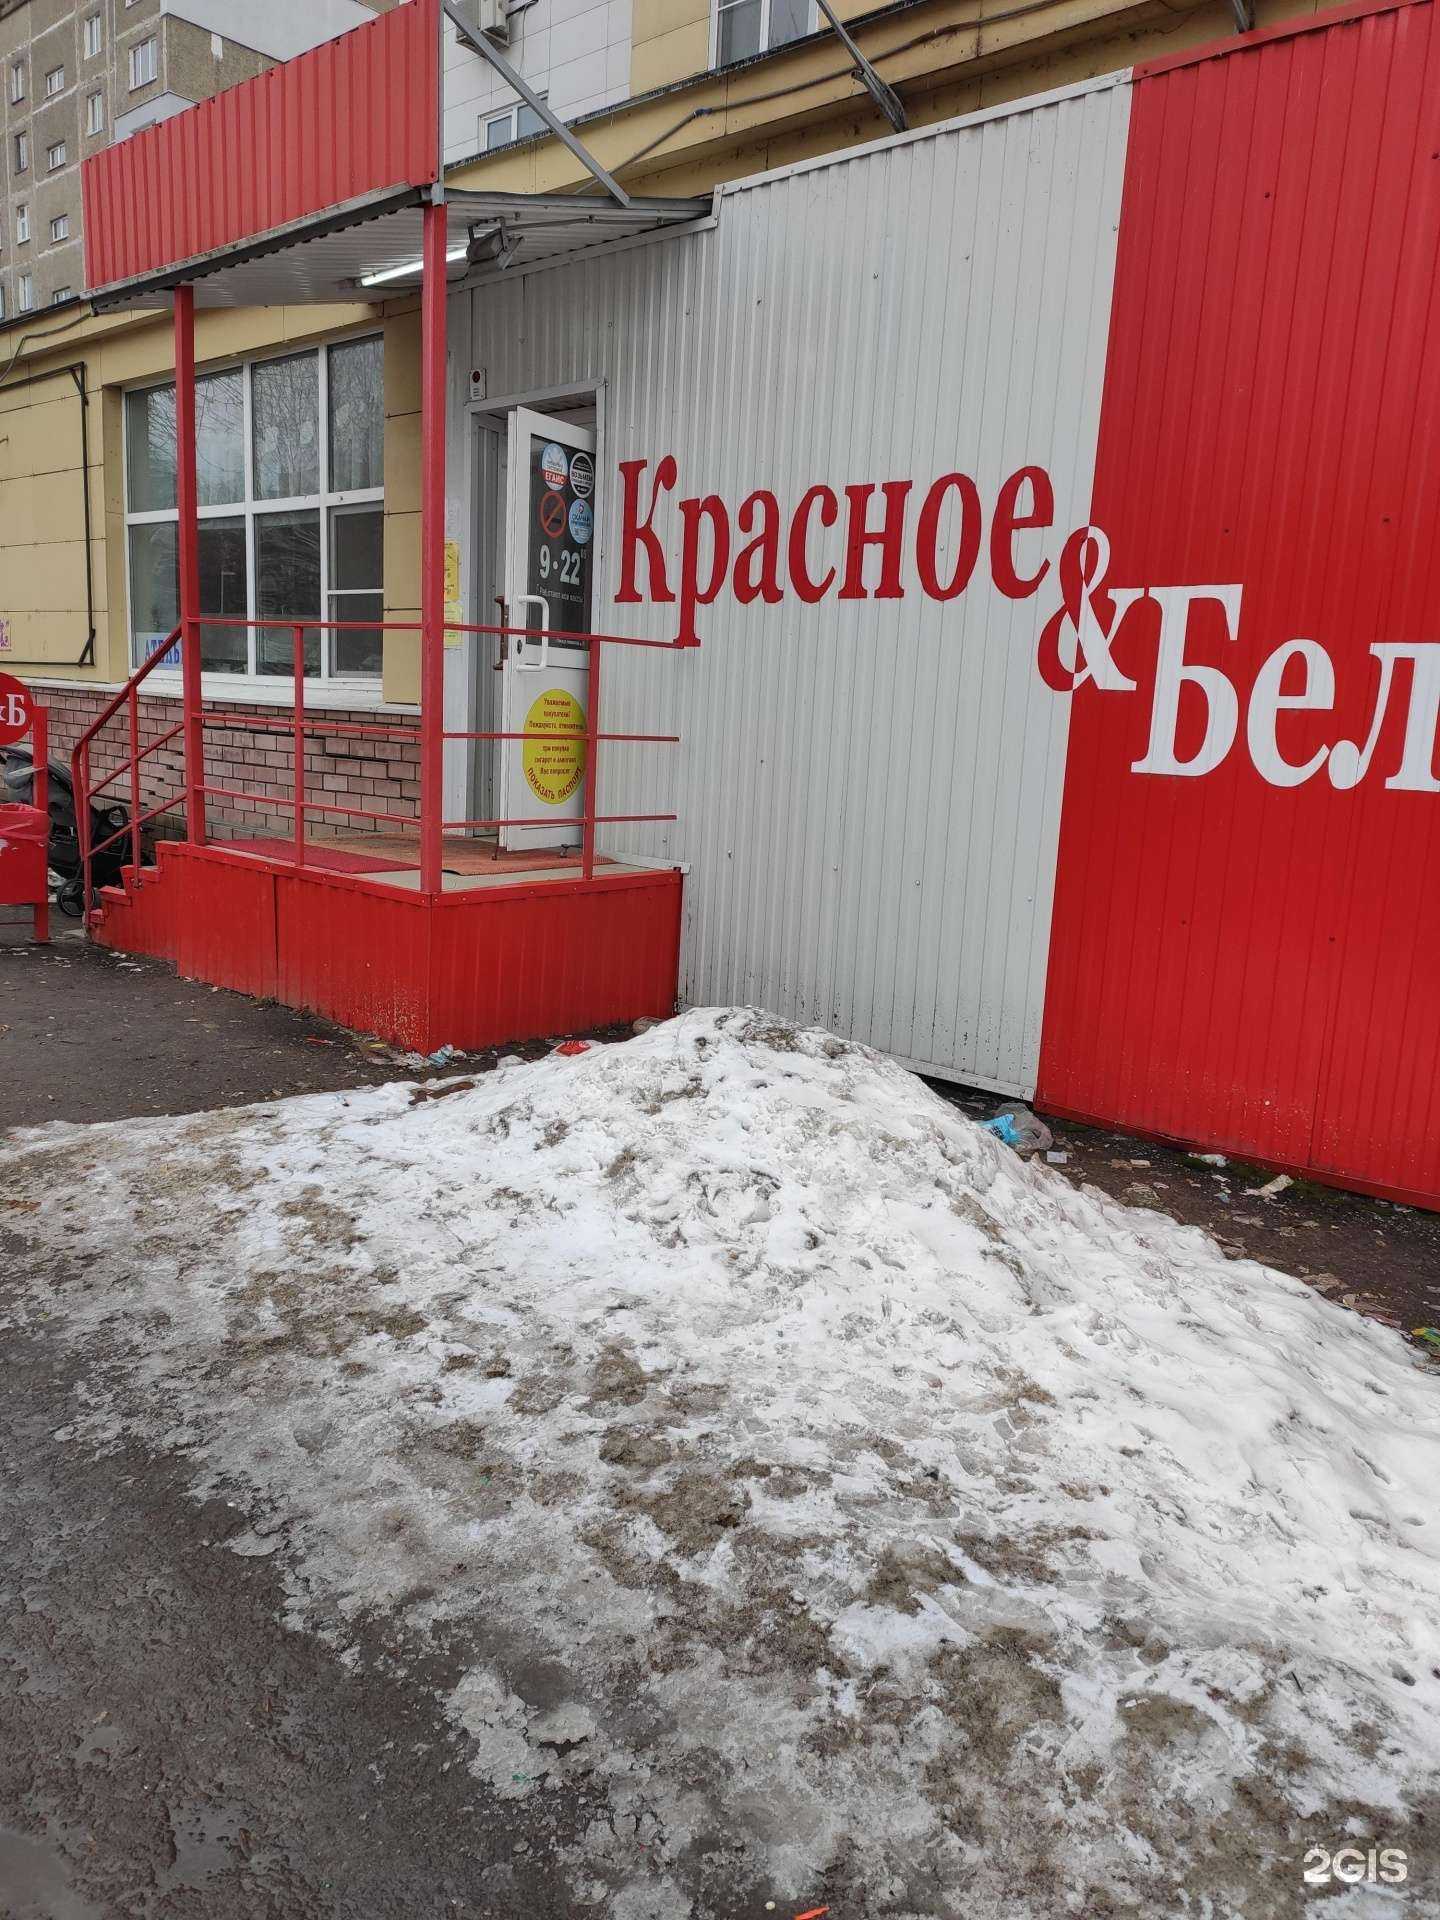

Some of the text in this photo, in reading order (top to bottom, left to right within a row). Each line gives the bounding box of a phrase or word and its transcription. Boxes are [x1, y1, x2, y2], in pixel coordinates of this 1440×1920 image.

[614, 455, 1054, 647] Красное
[1131, 583, 1440, 793] Бел
[527, 767, 555, 800] ПОКАЗАТЬ
